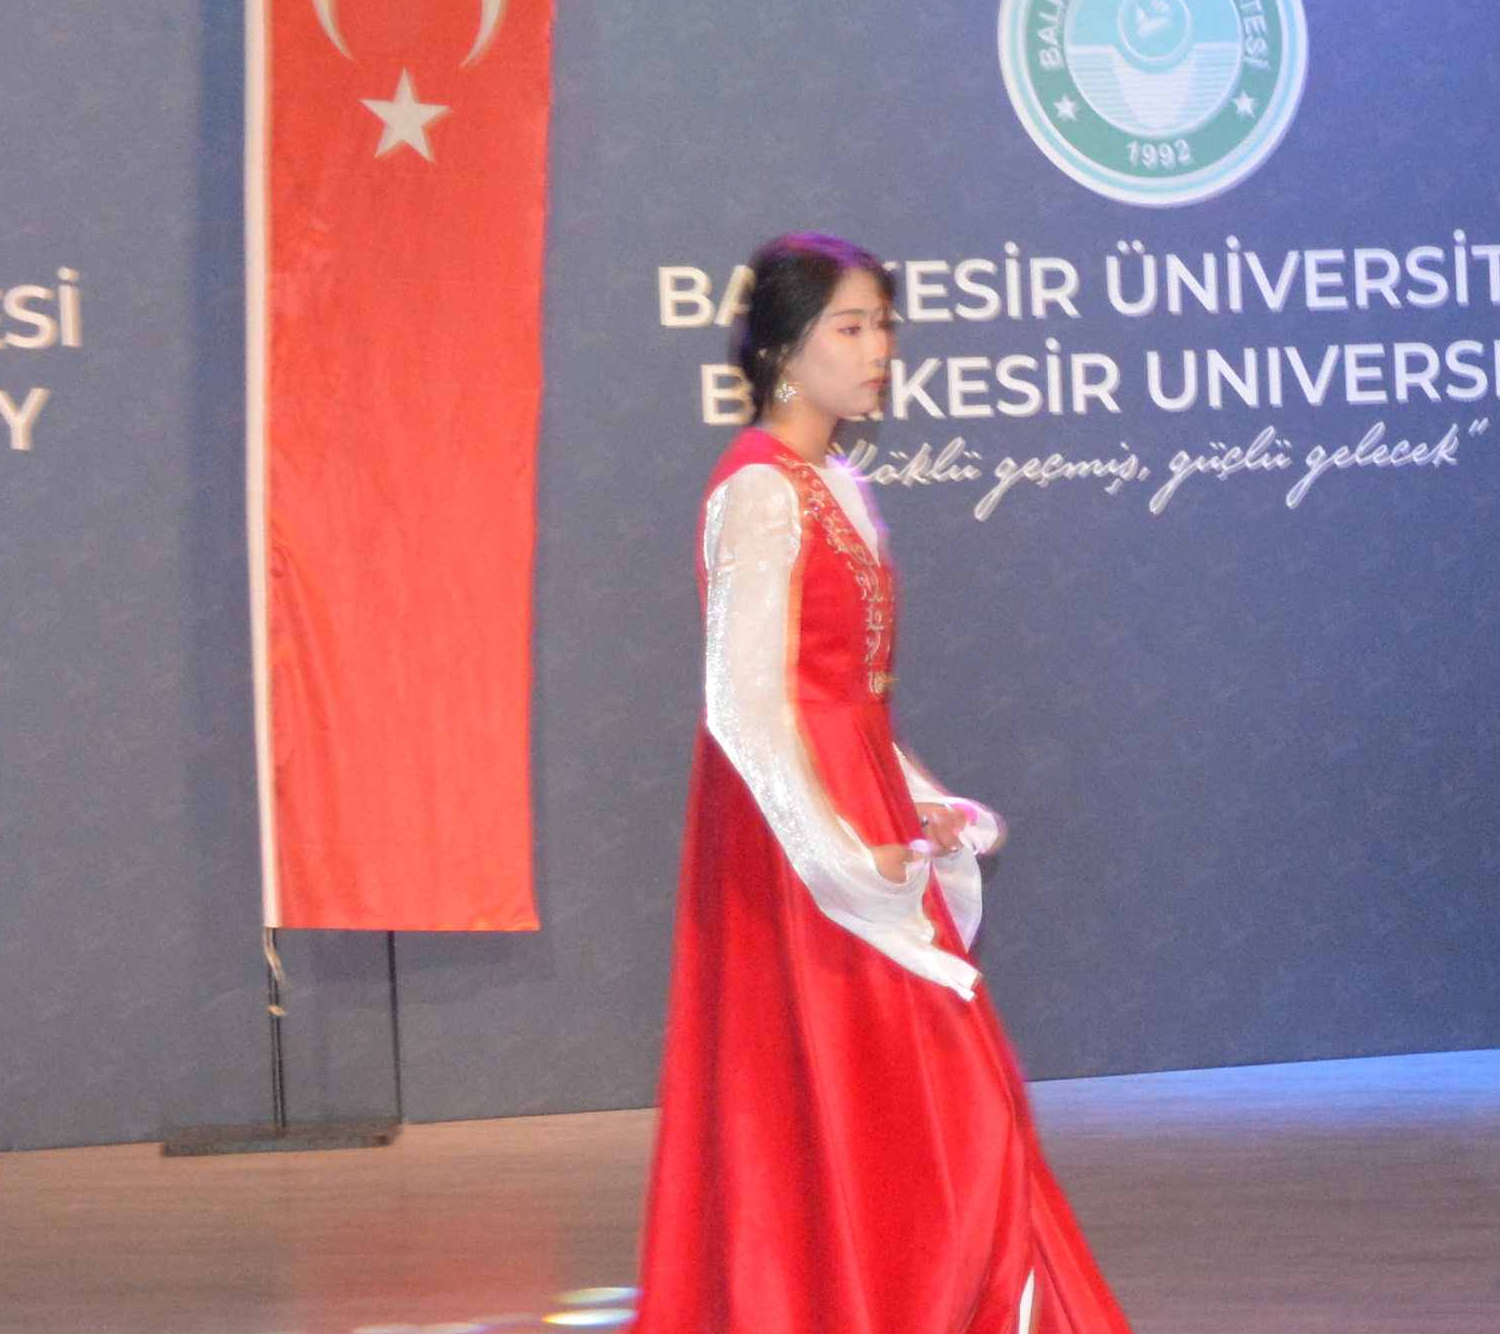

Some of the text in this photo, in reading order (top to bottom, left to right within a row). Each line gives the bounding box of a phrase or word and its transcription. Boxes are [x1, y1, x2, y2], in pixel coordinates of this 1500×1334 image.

[1126, 137, 1195, 169] 1992
[700, 337, 1121, 426] BKESİR
[1148, 425, 1293, 516] güçlü
